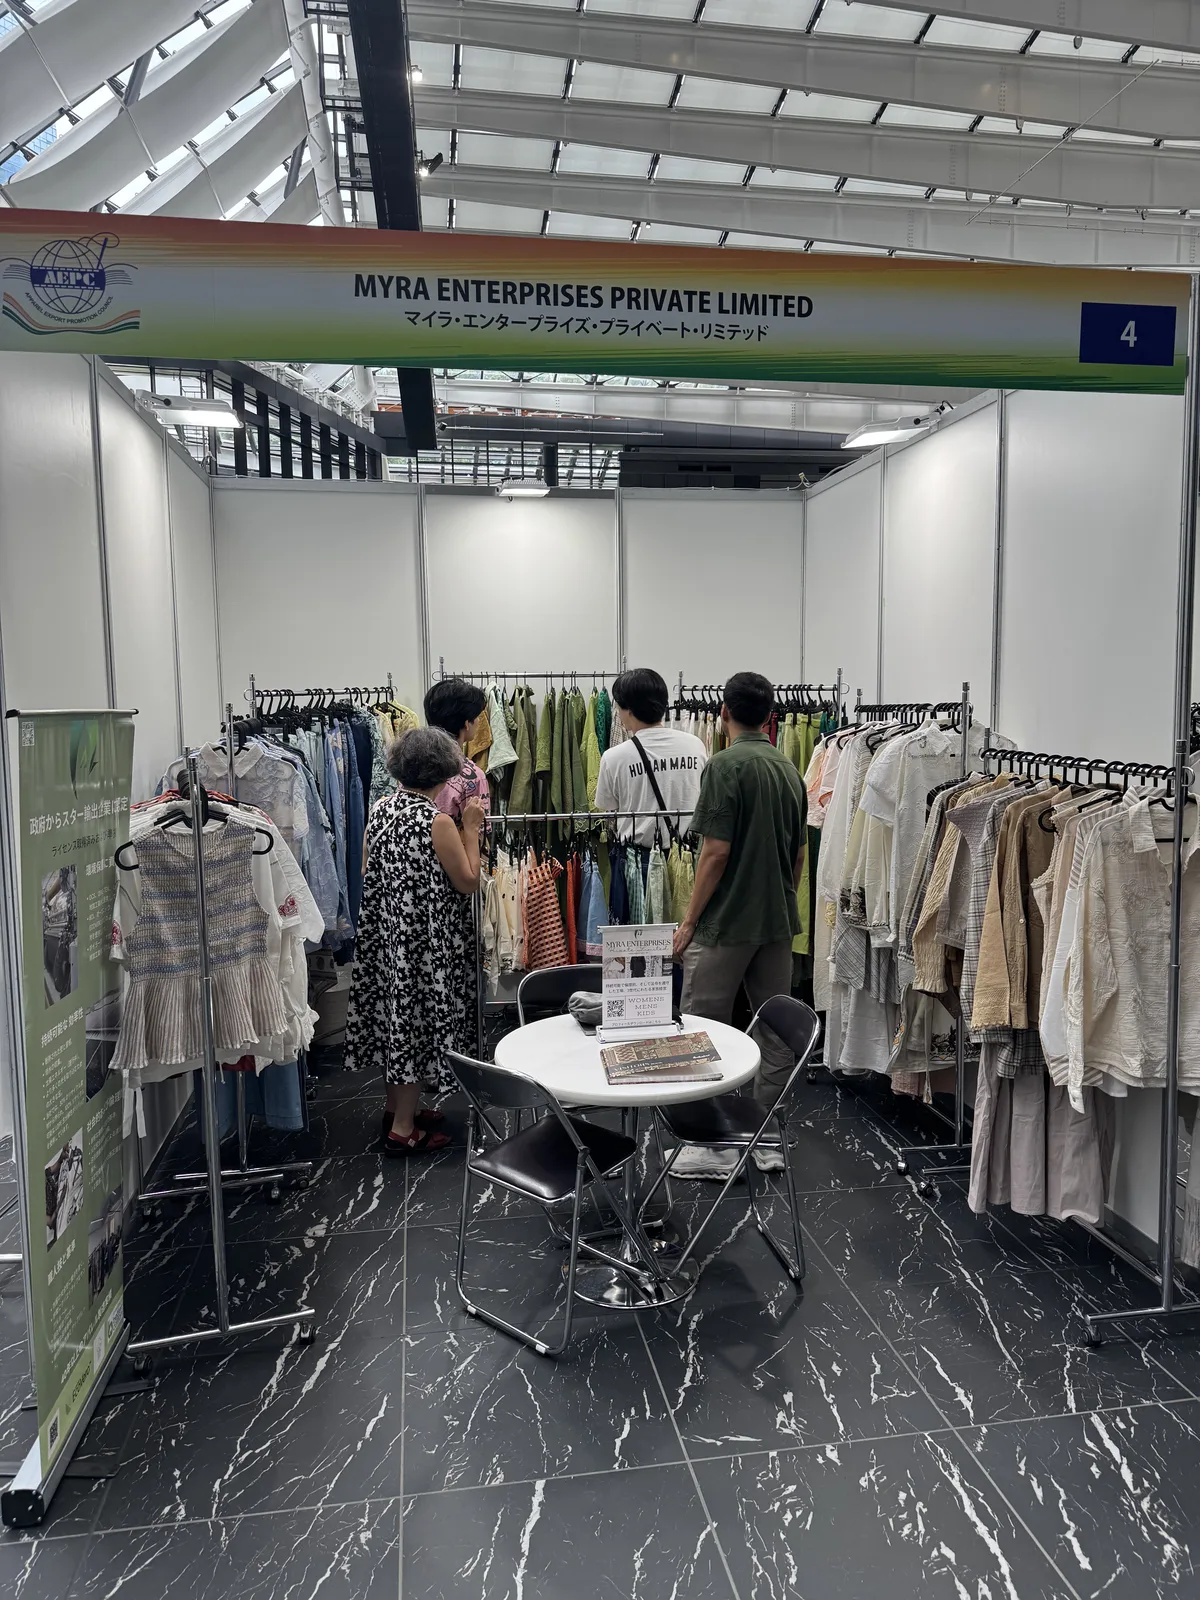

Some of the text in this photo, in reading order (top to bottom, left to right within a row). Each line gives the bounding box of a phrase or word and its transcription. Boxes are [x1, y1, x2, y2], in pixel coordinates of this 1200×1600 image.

[44, 270, 96, 286] AEPC
[354, 273, 814, 318] MYRA ENTERPRISES PRIVATE LIMITED
[25, 291, 114, 324] APPAREL EXPORT PROMOTION COUNCIL
[404, 310, 769, 342] マイラ・エンタープライズ・プライベート・リミテッド
[1120, 320, 1138, 348] 4
[669, 756, 698, 770] MADE
[605, 939, 671, 949] MYRA ENTERPRISES
[628, 996, 665, 1004] WOMENS
